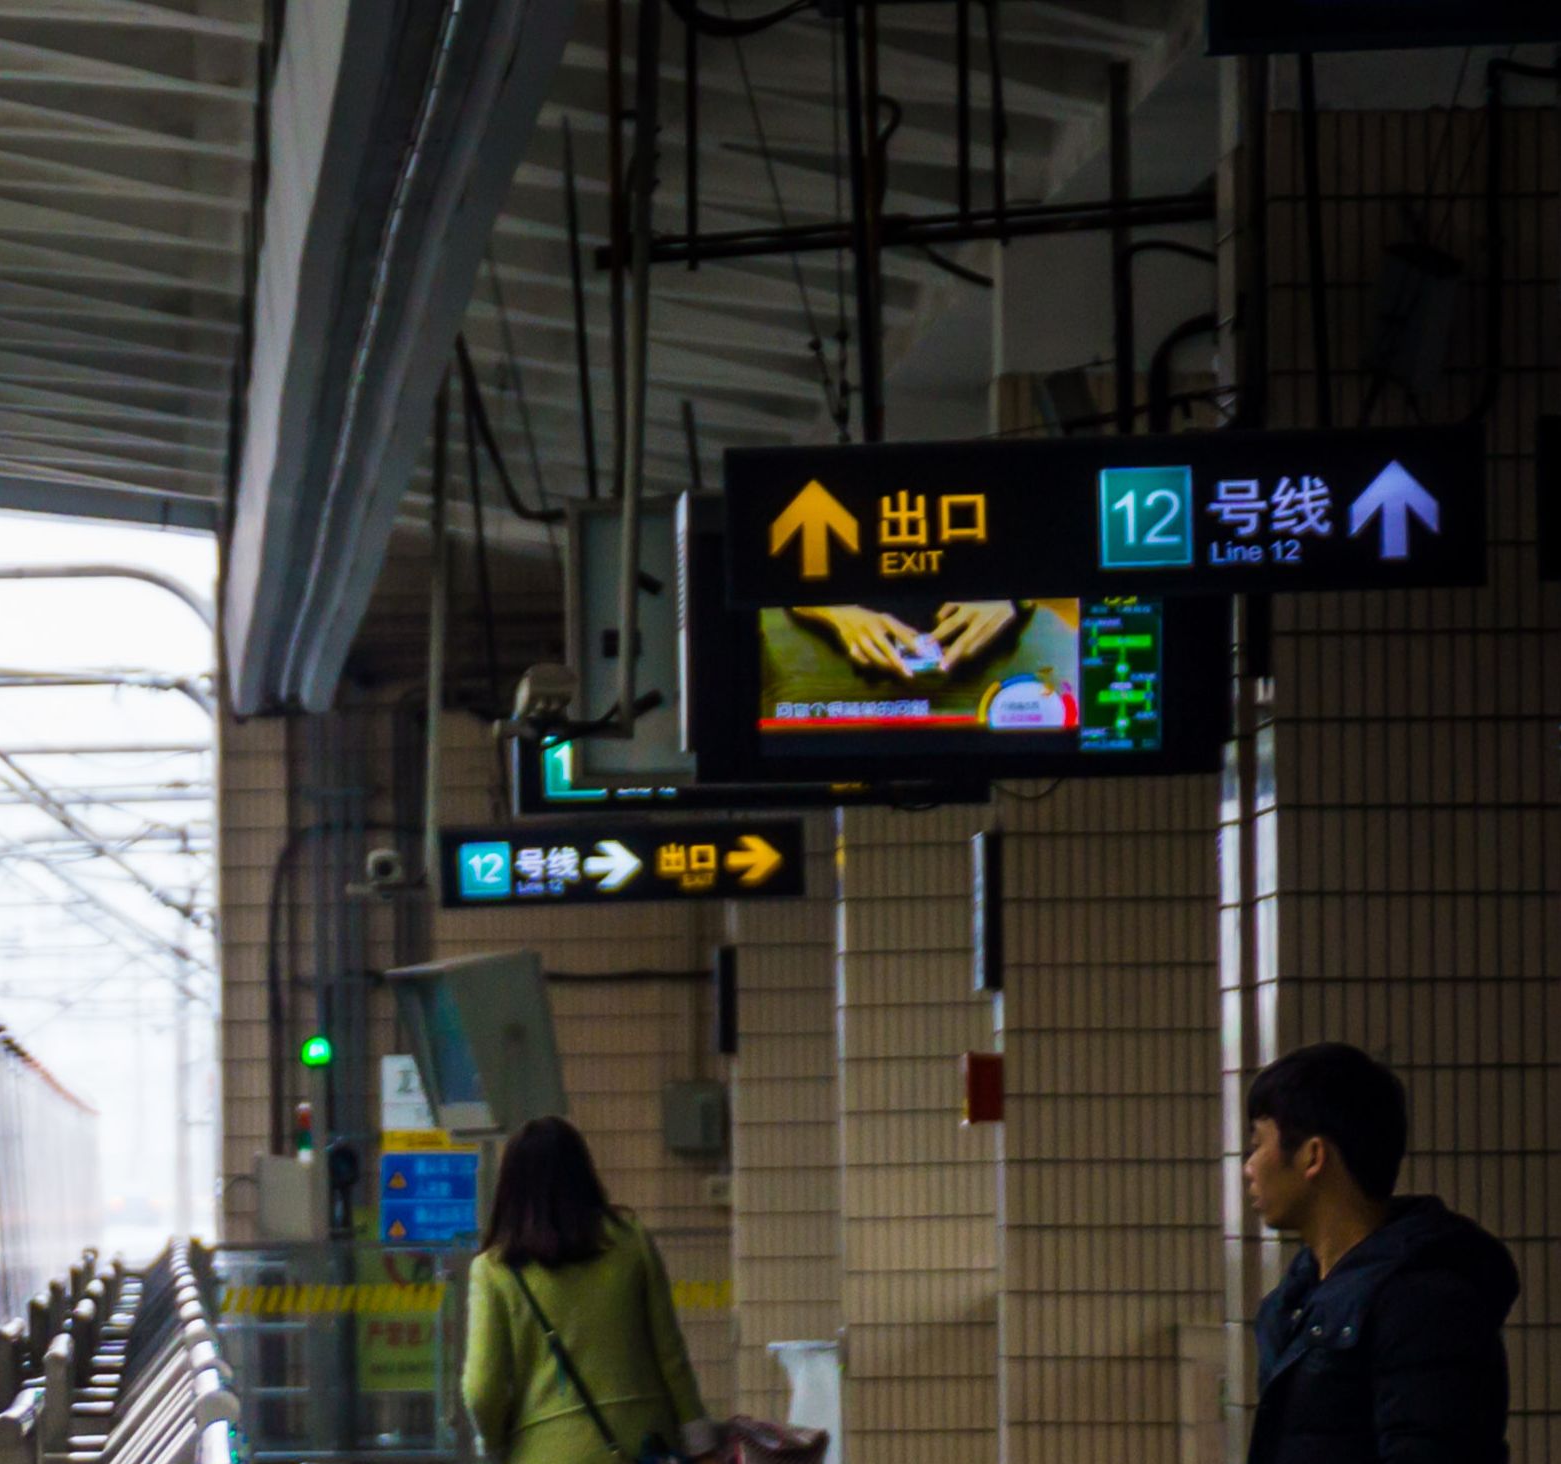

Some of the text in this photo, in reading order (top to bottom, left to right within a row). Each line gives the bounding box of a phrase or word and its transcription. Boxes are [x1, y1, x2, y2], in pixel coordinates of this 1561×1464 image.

[880, 489, 988, 545] 出口
[1113, 477, 1333, 546] 12 号线
[881, 550, 943, 574] EXIT
[1211, 540, 1300, 564] Line 12
[469, 846, 580, 884] 12 号线
[657, 843, 717, 873] 出口
